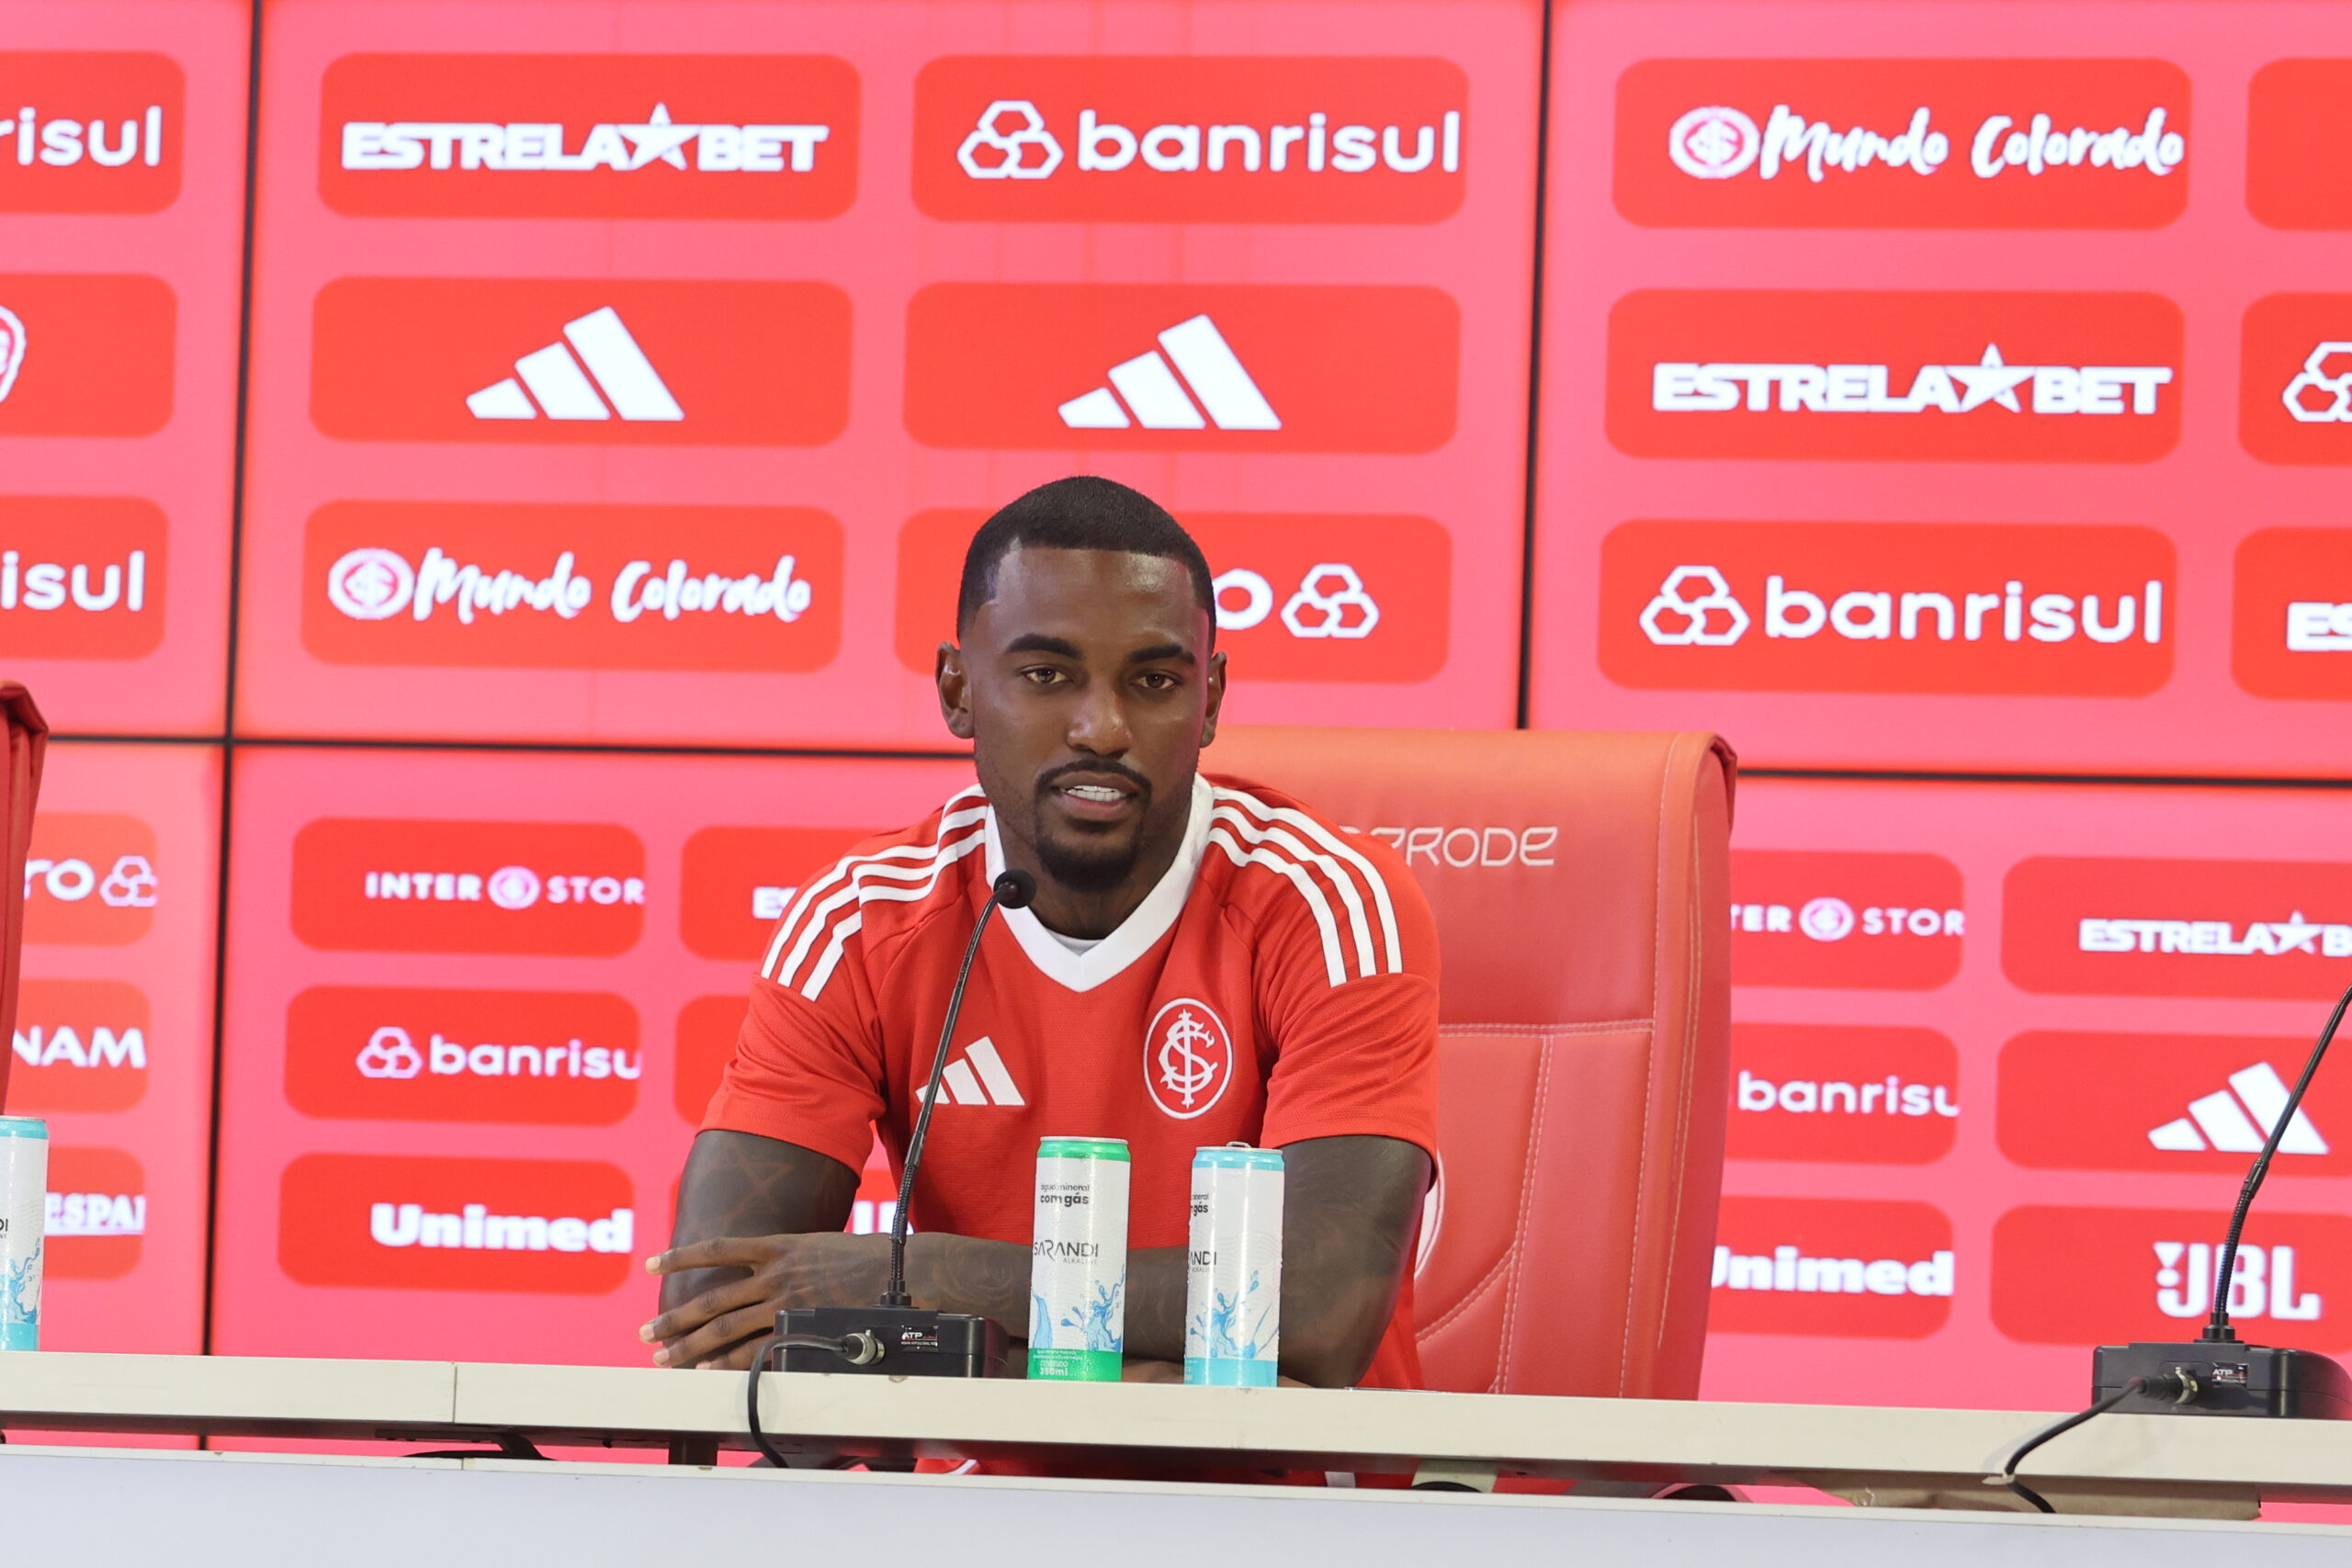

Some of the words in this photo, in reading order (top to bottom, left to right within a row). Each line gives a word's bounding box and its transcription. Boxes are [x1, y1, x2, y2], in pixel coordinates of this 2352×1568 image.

[1079, 110, 1459, 172] banrisul
[1760, 106, 1948, 182] Mundo
[1972, 108, 2183, 177] Colorado
[412, 548, 591, 624] Mundo
[612, 556, 810, 622] Colorado
[1766, 576, 2161, 642] banrisul
[366, 873, 481, 900] INTER
[548, 876, 644, 904] STOR
[1862, 906, 1965, 937] STOR
[1040, 1194, 1063, 1203] com
[1064, 1192, 1090, 1208] gás
[369, 1202, 635, 1255] Unimed
[1034, 1239, 1099, 1262] SARANDI
[2153, 1242, 2323, 1321] JBL
[902, 1332, 923, 1340] ATP
